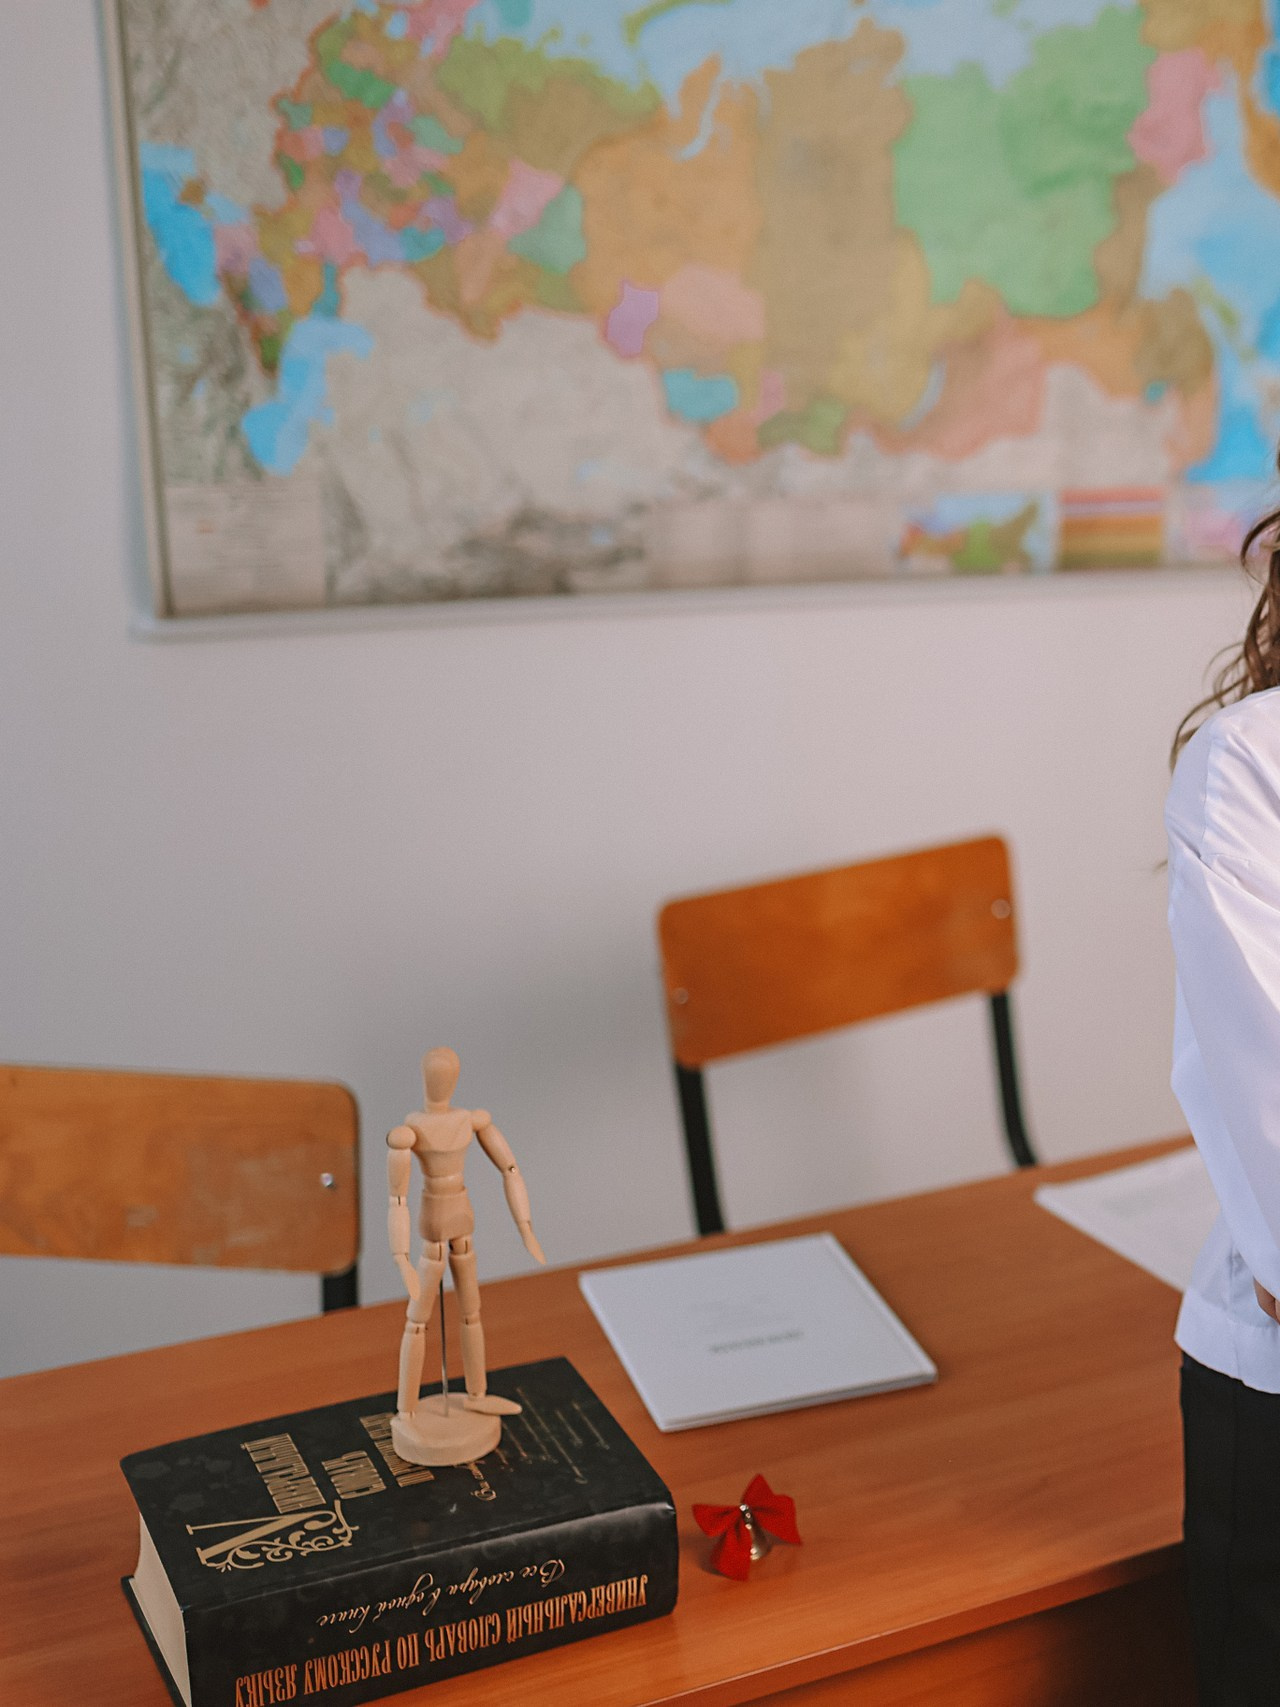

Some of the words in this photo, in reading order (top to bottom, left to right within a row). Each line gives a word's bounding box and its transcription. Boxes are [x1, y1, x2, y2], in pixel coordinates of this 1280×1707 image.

[446, 1567, 515, 1605] словари
[519, 1559, 565, 1587] Все
[372, 1573, 433, 1622] одной
[422, 1586, 441, 1616] в
[506, 1574, 648, 1644] УНИВЕРСАЛЬНЫЙ
[316, 1604, 370, 1633] книге
[424, 1612, 501, 1662] СЛОВАРЬ
[303, 1639, 392, 1696] РУССКОМУ
[397, 1633, 420, 1670] ПО
[235, 1663, 298, 1707] ЯЗЫКУ
